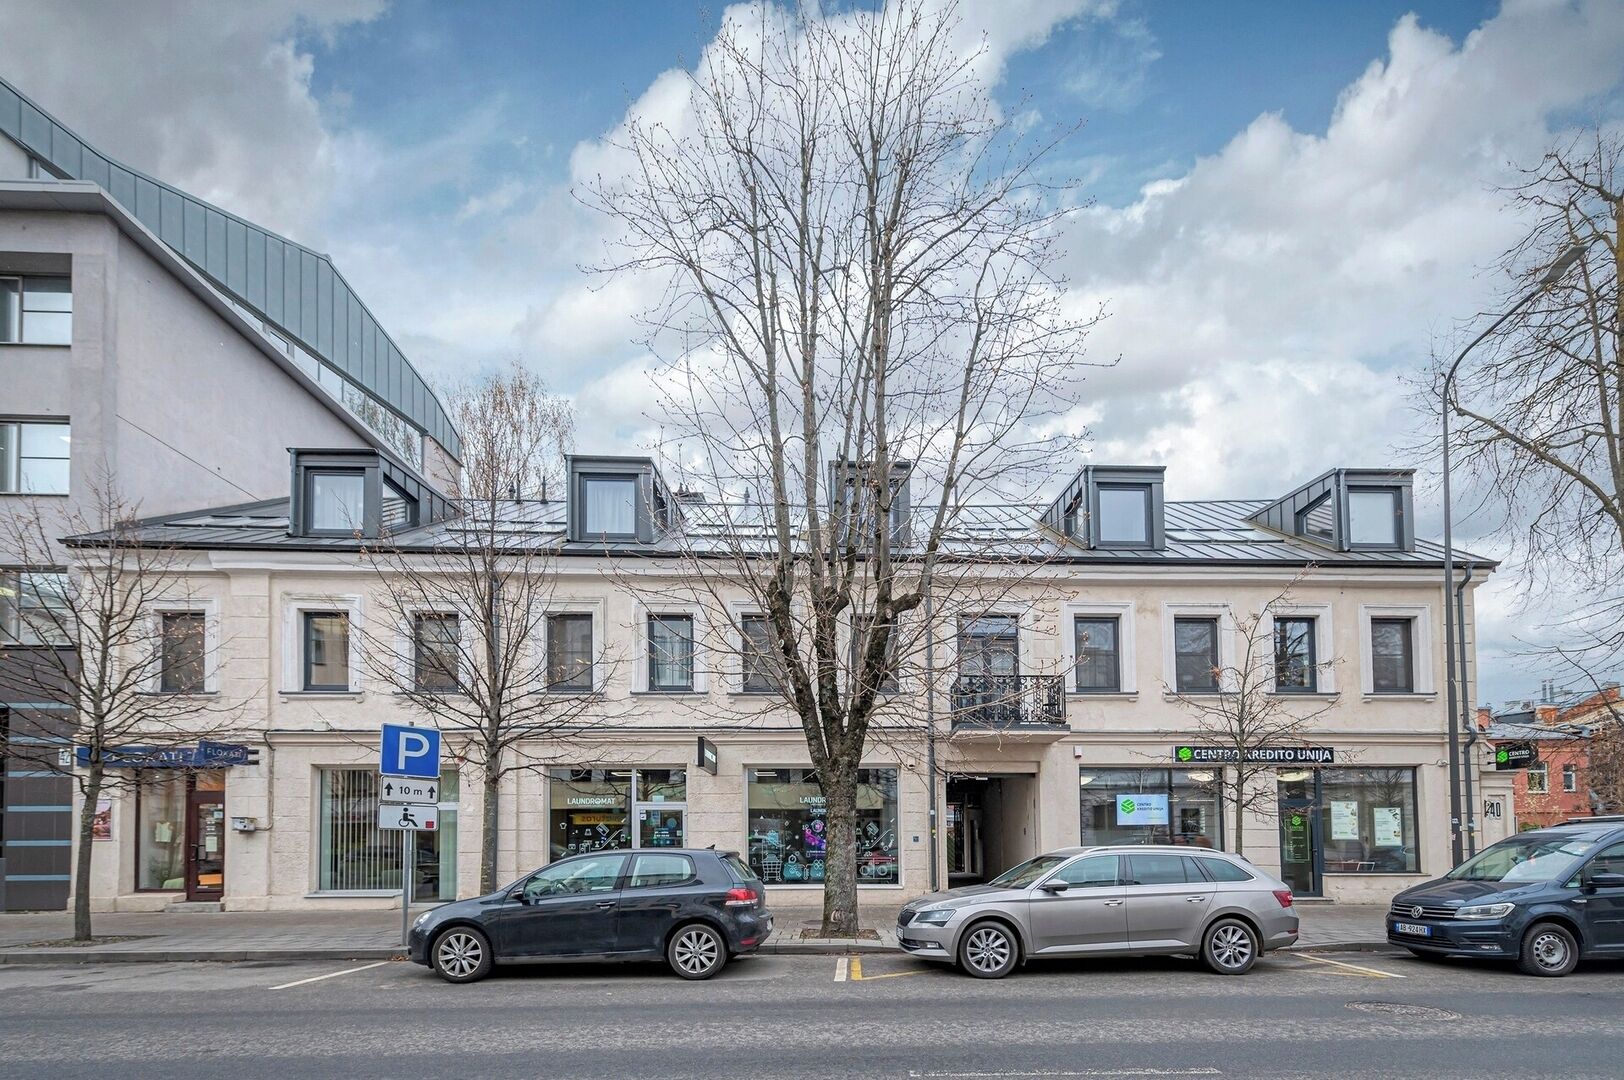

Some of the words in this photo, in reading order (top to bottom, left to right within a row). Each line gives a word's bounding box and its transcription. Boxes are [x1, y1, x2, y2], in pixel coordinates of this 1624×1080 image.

[398, 731, 430, 770] P
[1193, 749, 1240, 760] CENTRO
[1244, 749, 1294, 760] KREDITO
[1297, 750, 1332, 762] UNIJA
[399, 786, 411, 796] 10
[567, 797, 616, 805] LAUNDROMAT
